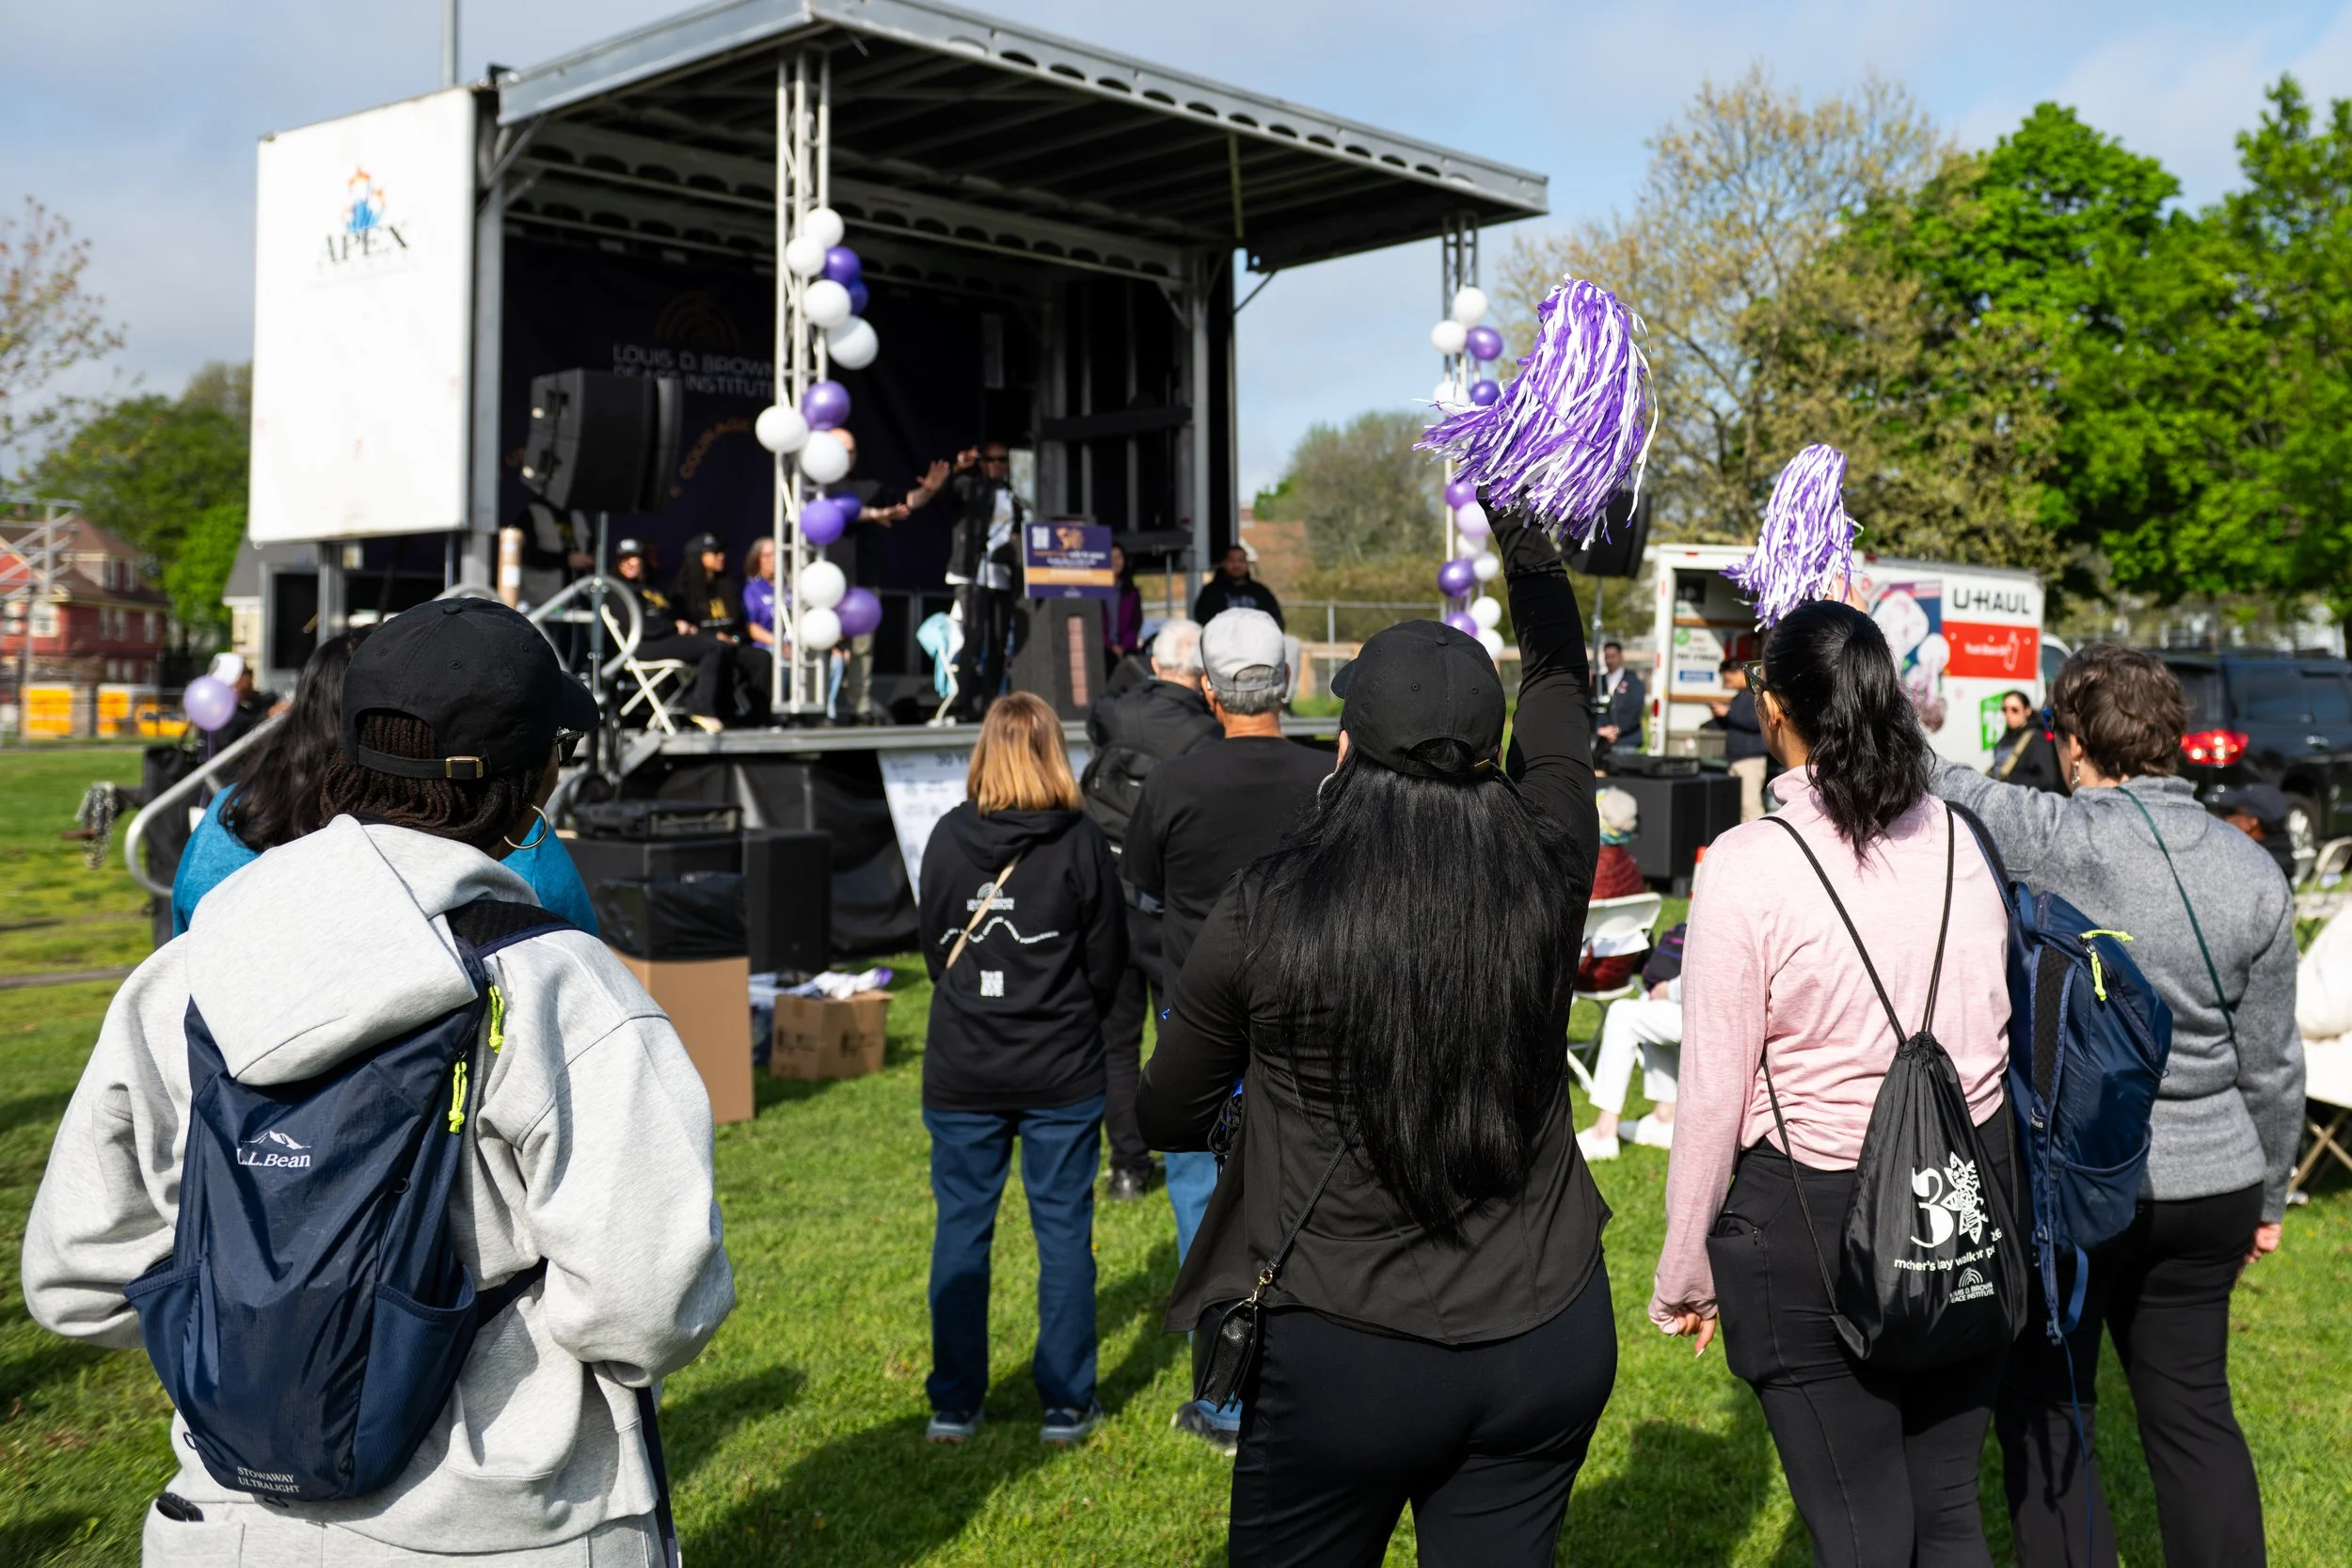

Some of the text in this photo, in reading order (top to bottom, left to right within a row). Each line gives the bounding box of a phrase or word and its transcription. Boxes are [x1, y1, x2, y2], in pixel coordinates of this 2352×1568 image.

[318, 221, 410, 276] APEX
[613, 343, 675, 370] LOUIS
[236, 1148, 311, 1168] L.L.Bean
[1955, 1251, 1977, 1267] walk
[1966, 1287, 1994, 1302] INSTITUTE
[237, 1465, 294, 1483] STOWAWAY
[238, 1477, 300, 1493] ULTRALIGHT
